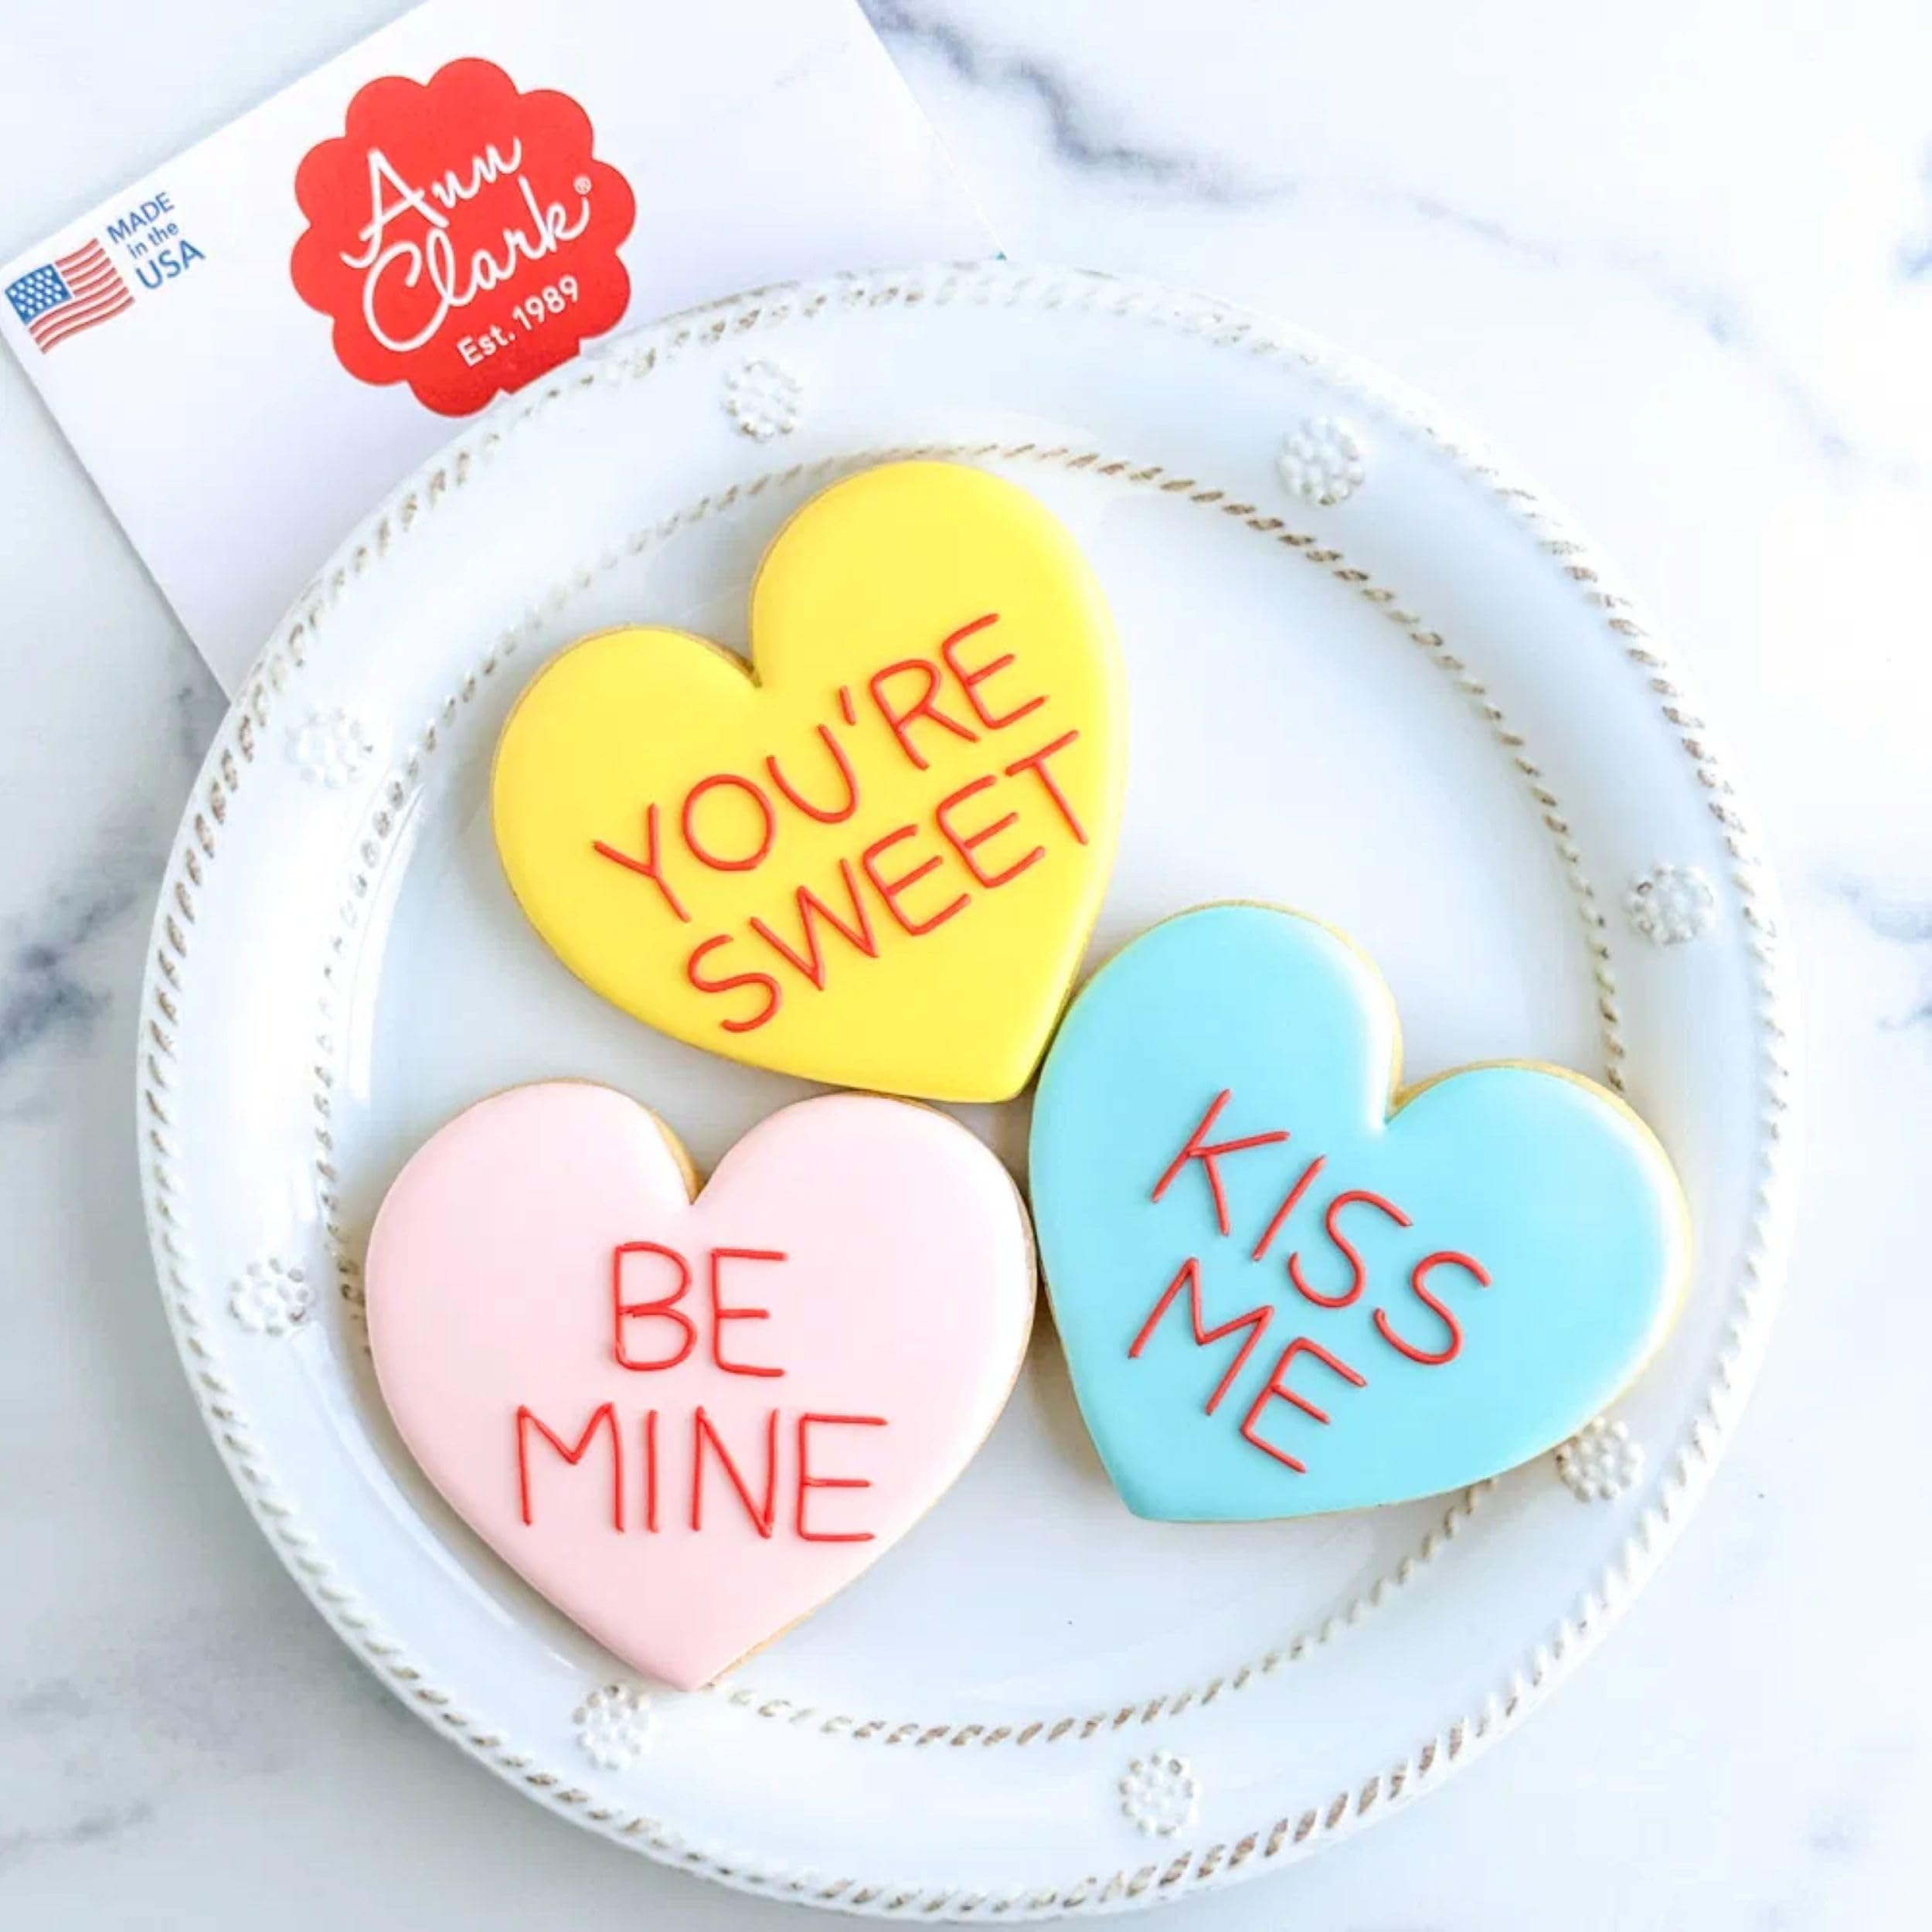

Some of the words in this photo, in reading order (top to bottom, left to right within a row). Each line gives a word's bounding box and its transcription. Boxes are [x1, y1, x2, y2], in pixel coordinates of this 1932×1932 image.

[106, 192, 175, 243] MADE
[126, 243, 148, 259] in
[148, 222, 179, 247] the
[134, 239, 206, 290] USA
[340, 136, 522, 269] Ann
[457, 325, 516, 366] Est.
[512, 274, 578, 332] 1989
[592, 613, 1051, 923] YOU'RE
[686, 729, 1090, 1033] SWEET
[1151, 1088, 1491, 1366] KISS
[610, 1240, 787, 1378] BE
[1128, 1257, 1367, 1474] ME
[514, 1402, 888, 1544] MINE
